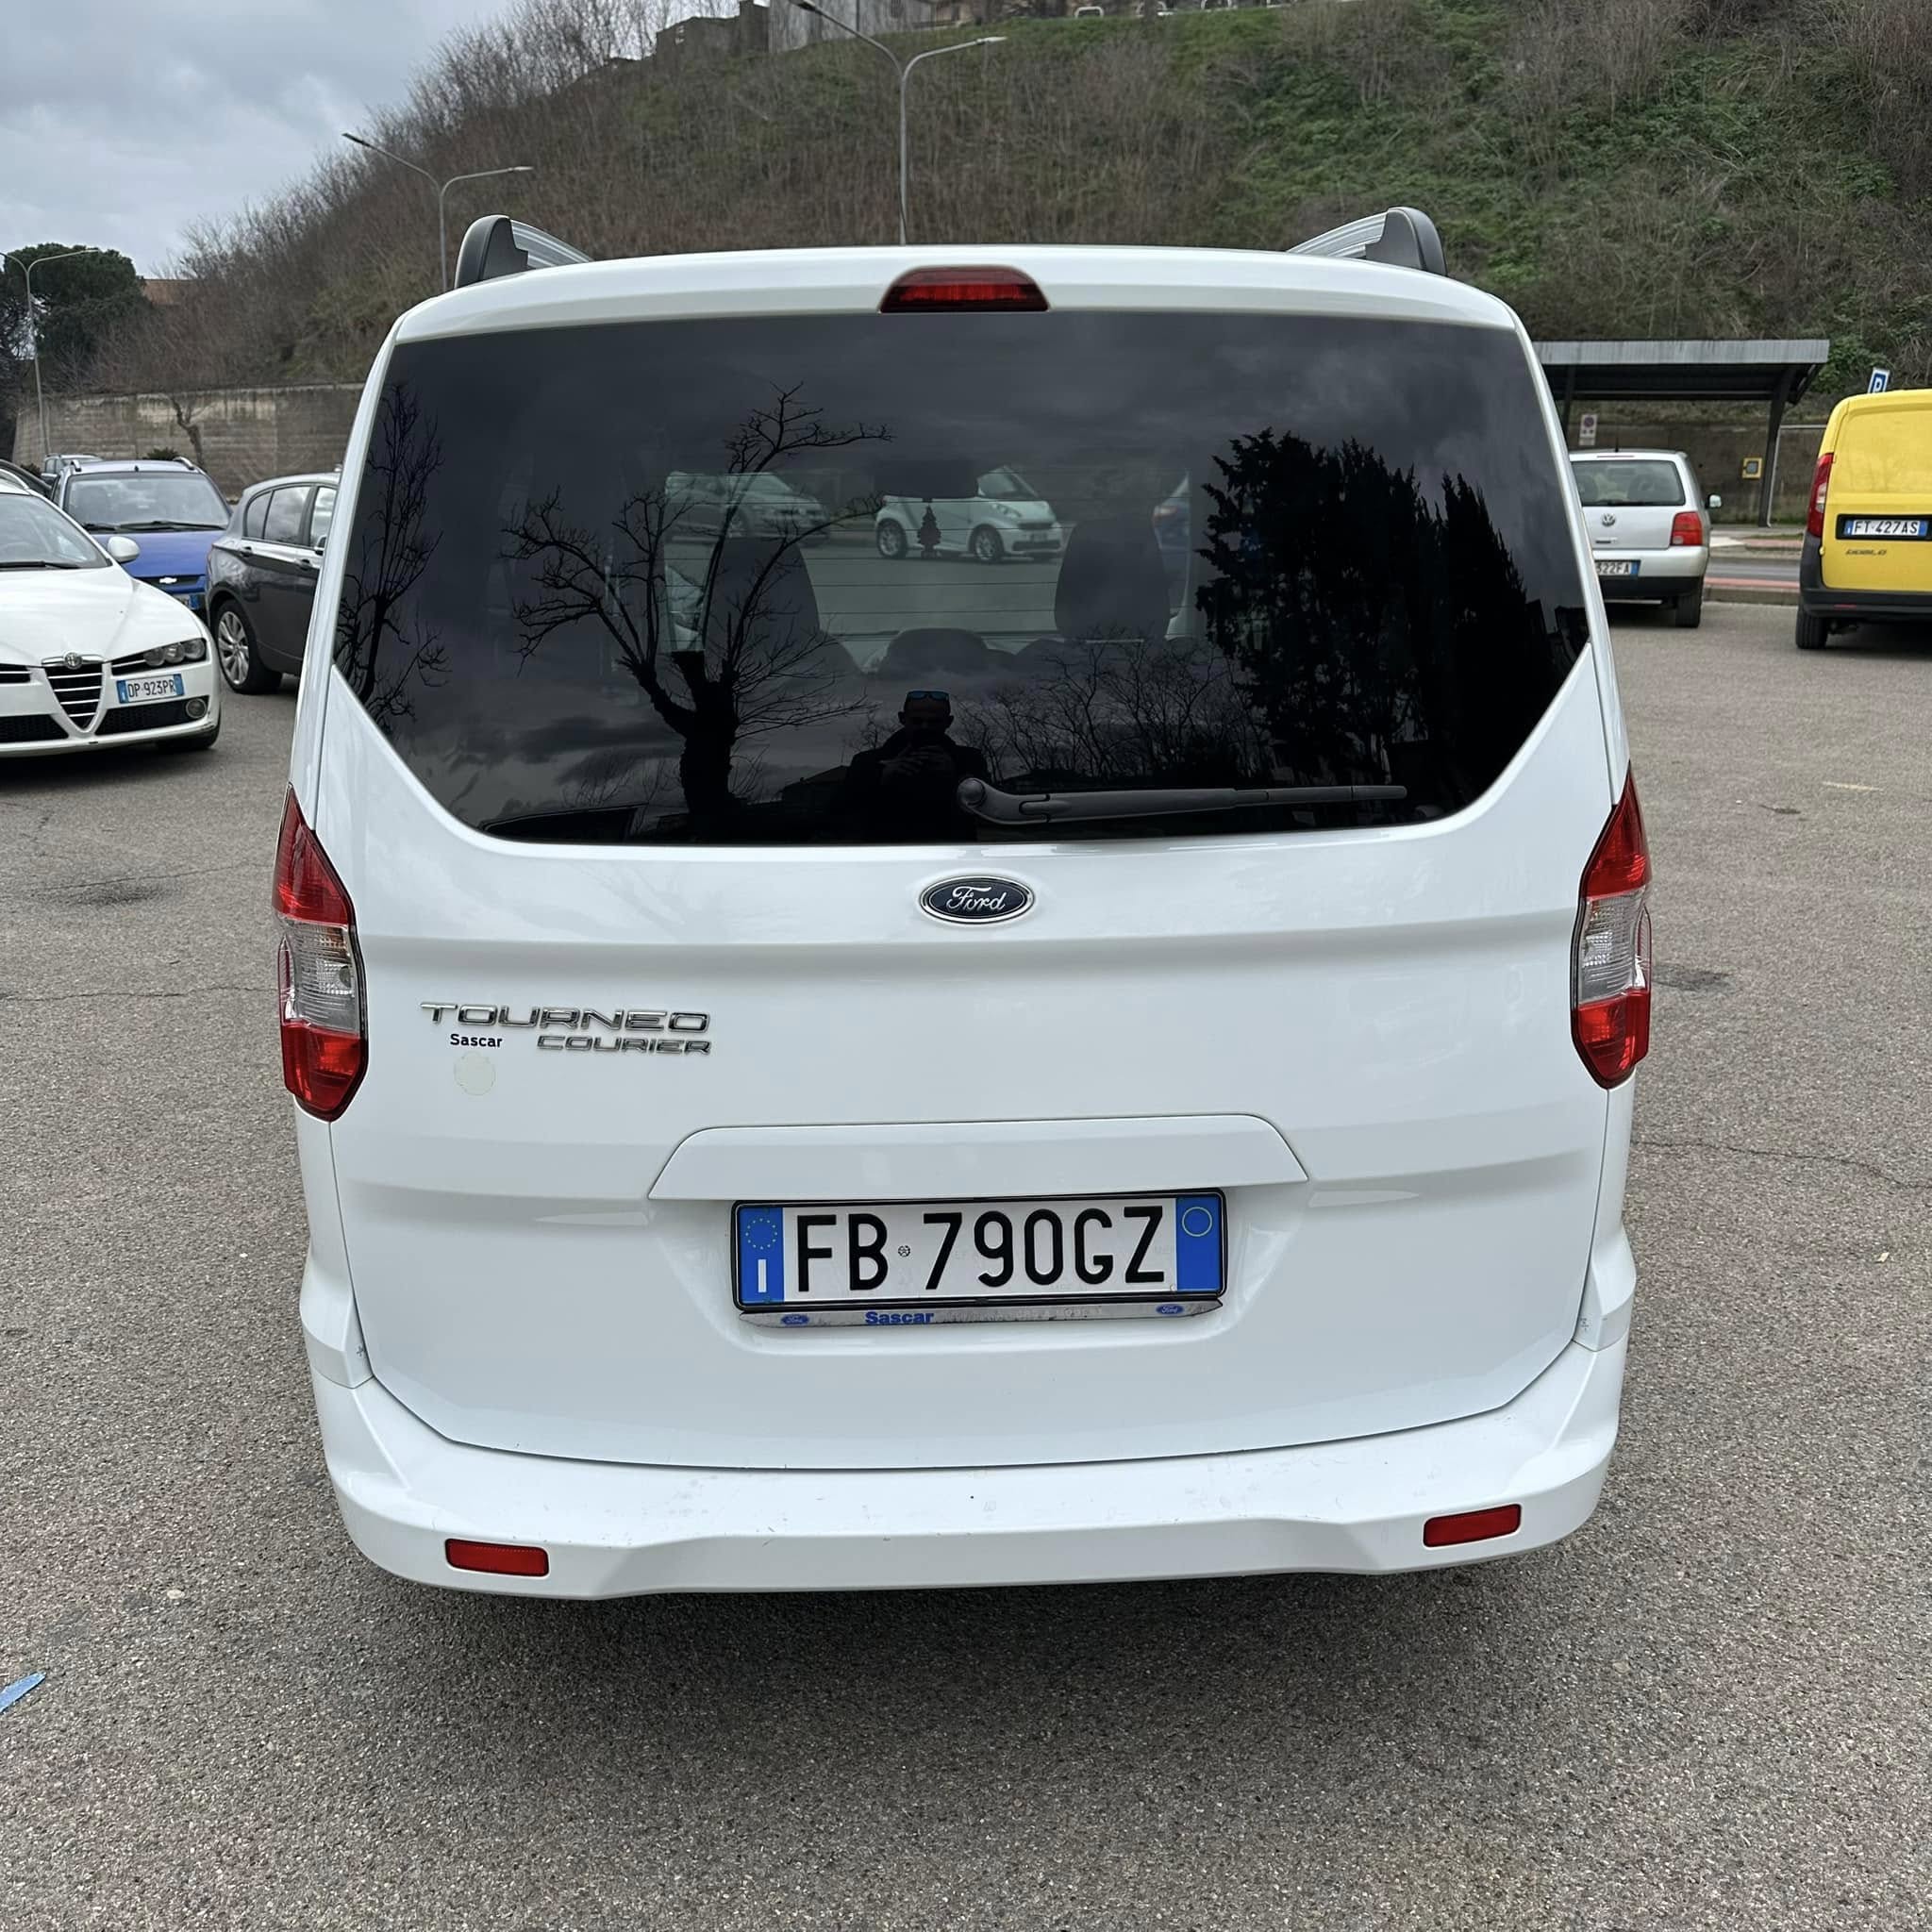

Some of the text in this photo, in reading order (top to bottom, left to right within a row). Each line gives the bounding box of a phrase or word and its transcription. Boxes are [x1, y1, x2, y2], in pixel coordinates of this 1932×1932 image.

[1855, 521, 1919, 534] FT 427AS
[127, 679, 176, 698] DP 923PR
[946, 886, 1008, 912] Ford
[420, 1001, 710, 1034] TOURNEO
[450, 1033, 503, 1049] Sascar
[537, 1035, 711, 1056] COURIER
[796, 1206, 1165, 1291] FB 790GZ
[865, 1311, 935, 1325] Sascar
